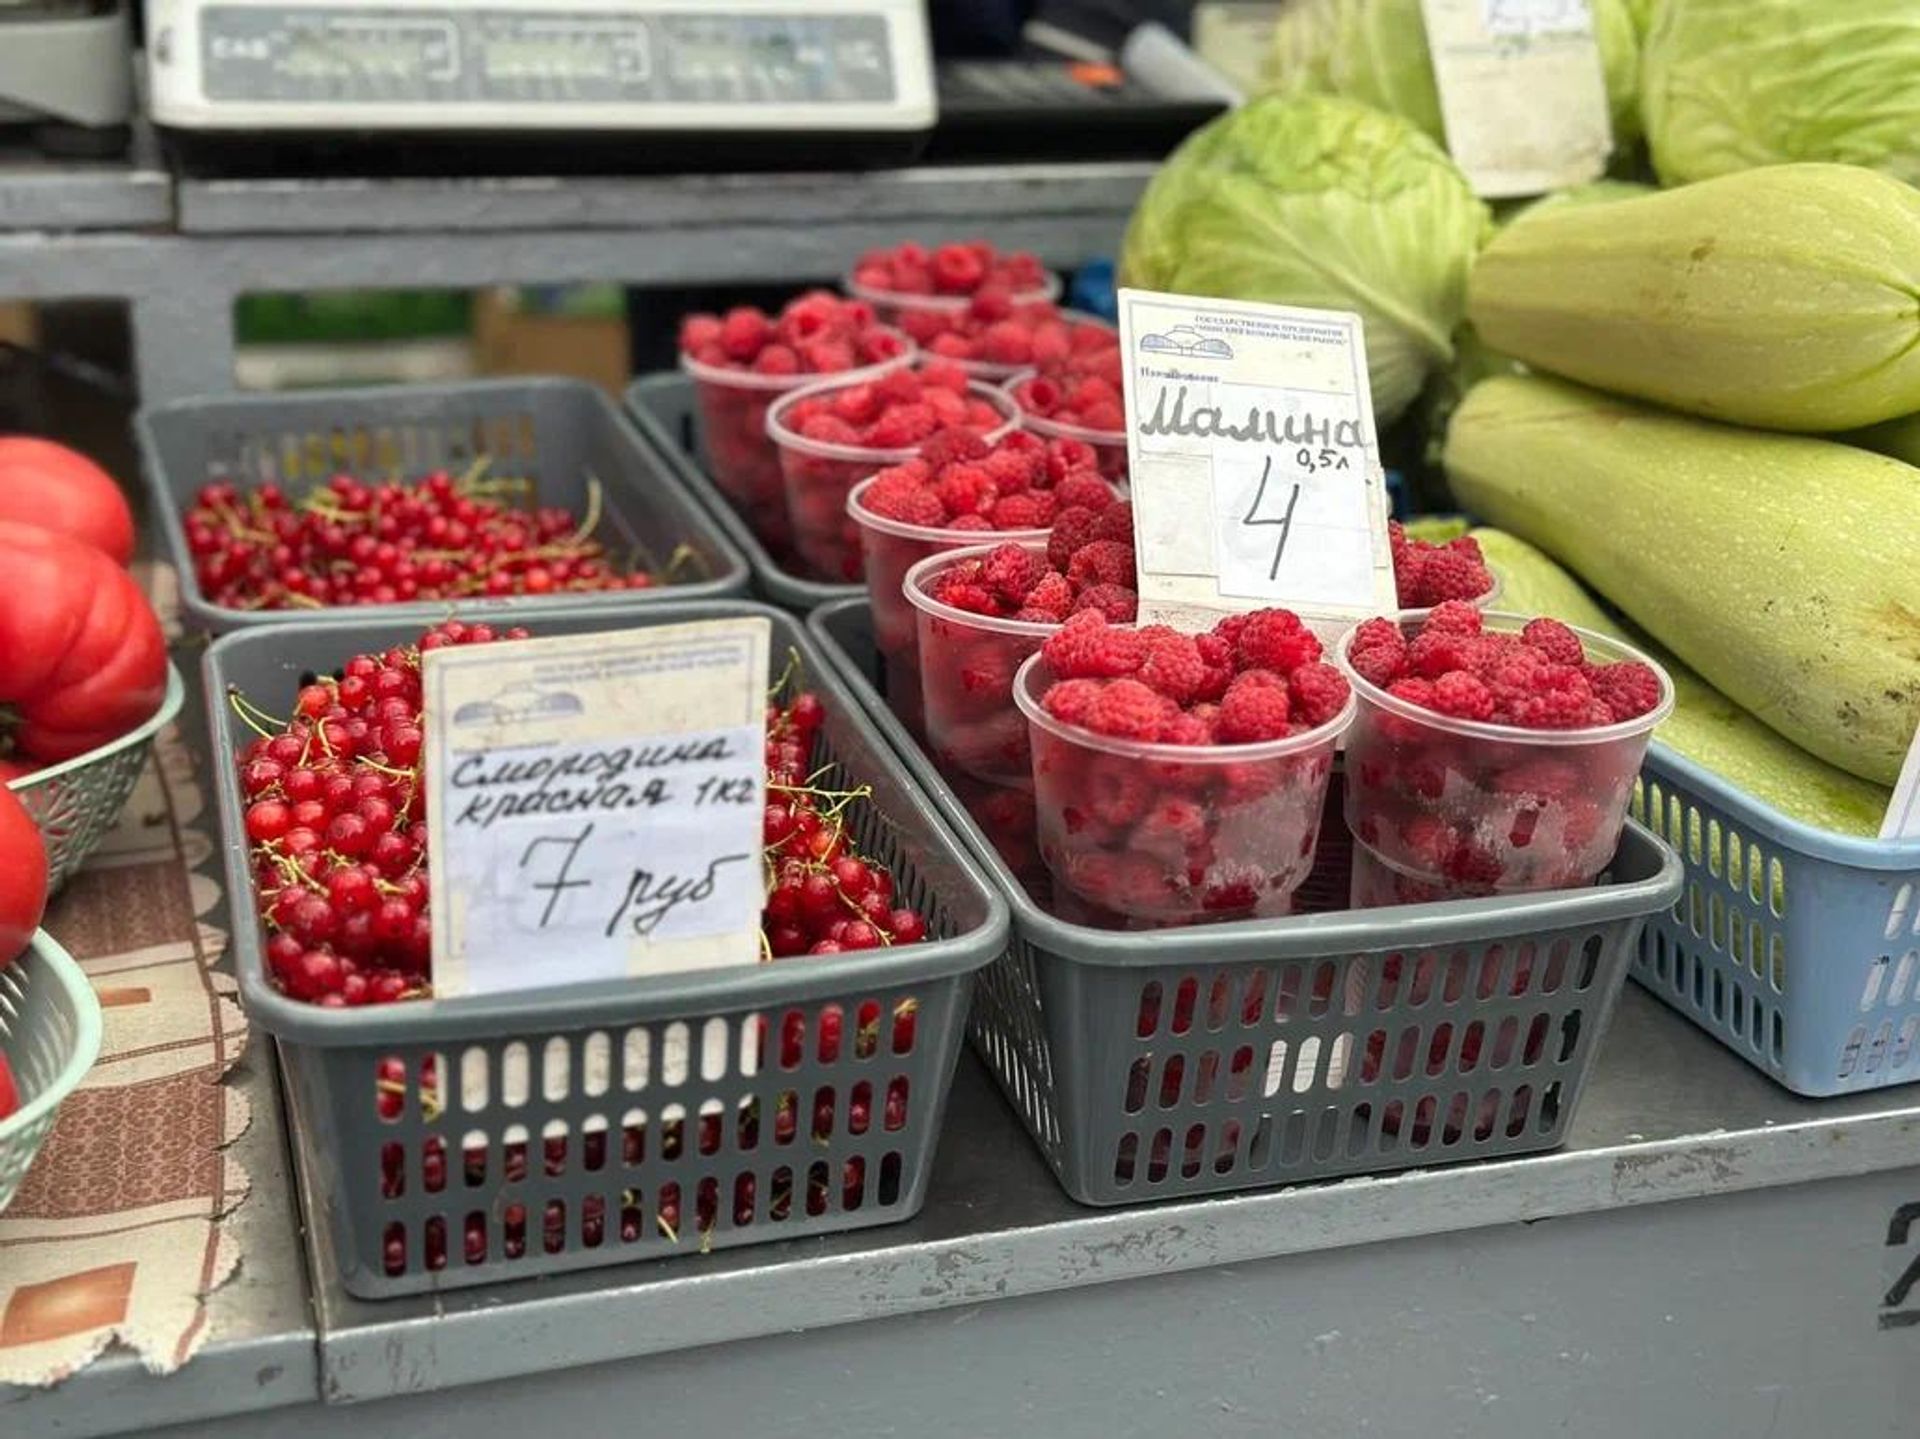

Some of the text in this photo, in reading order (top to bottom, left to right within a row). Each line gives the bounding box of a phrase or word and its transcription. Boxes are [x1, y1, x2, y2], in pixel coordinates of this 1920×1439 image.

[1139, 386, 1365, 448] Малина
[1243, 456, 1299, 581] 4
[453, 737, 735, 789] Смородина
[455, 781, 675, 829] красная
[519, 822, 750, 938] 7 руб
